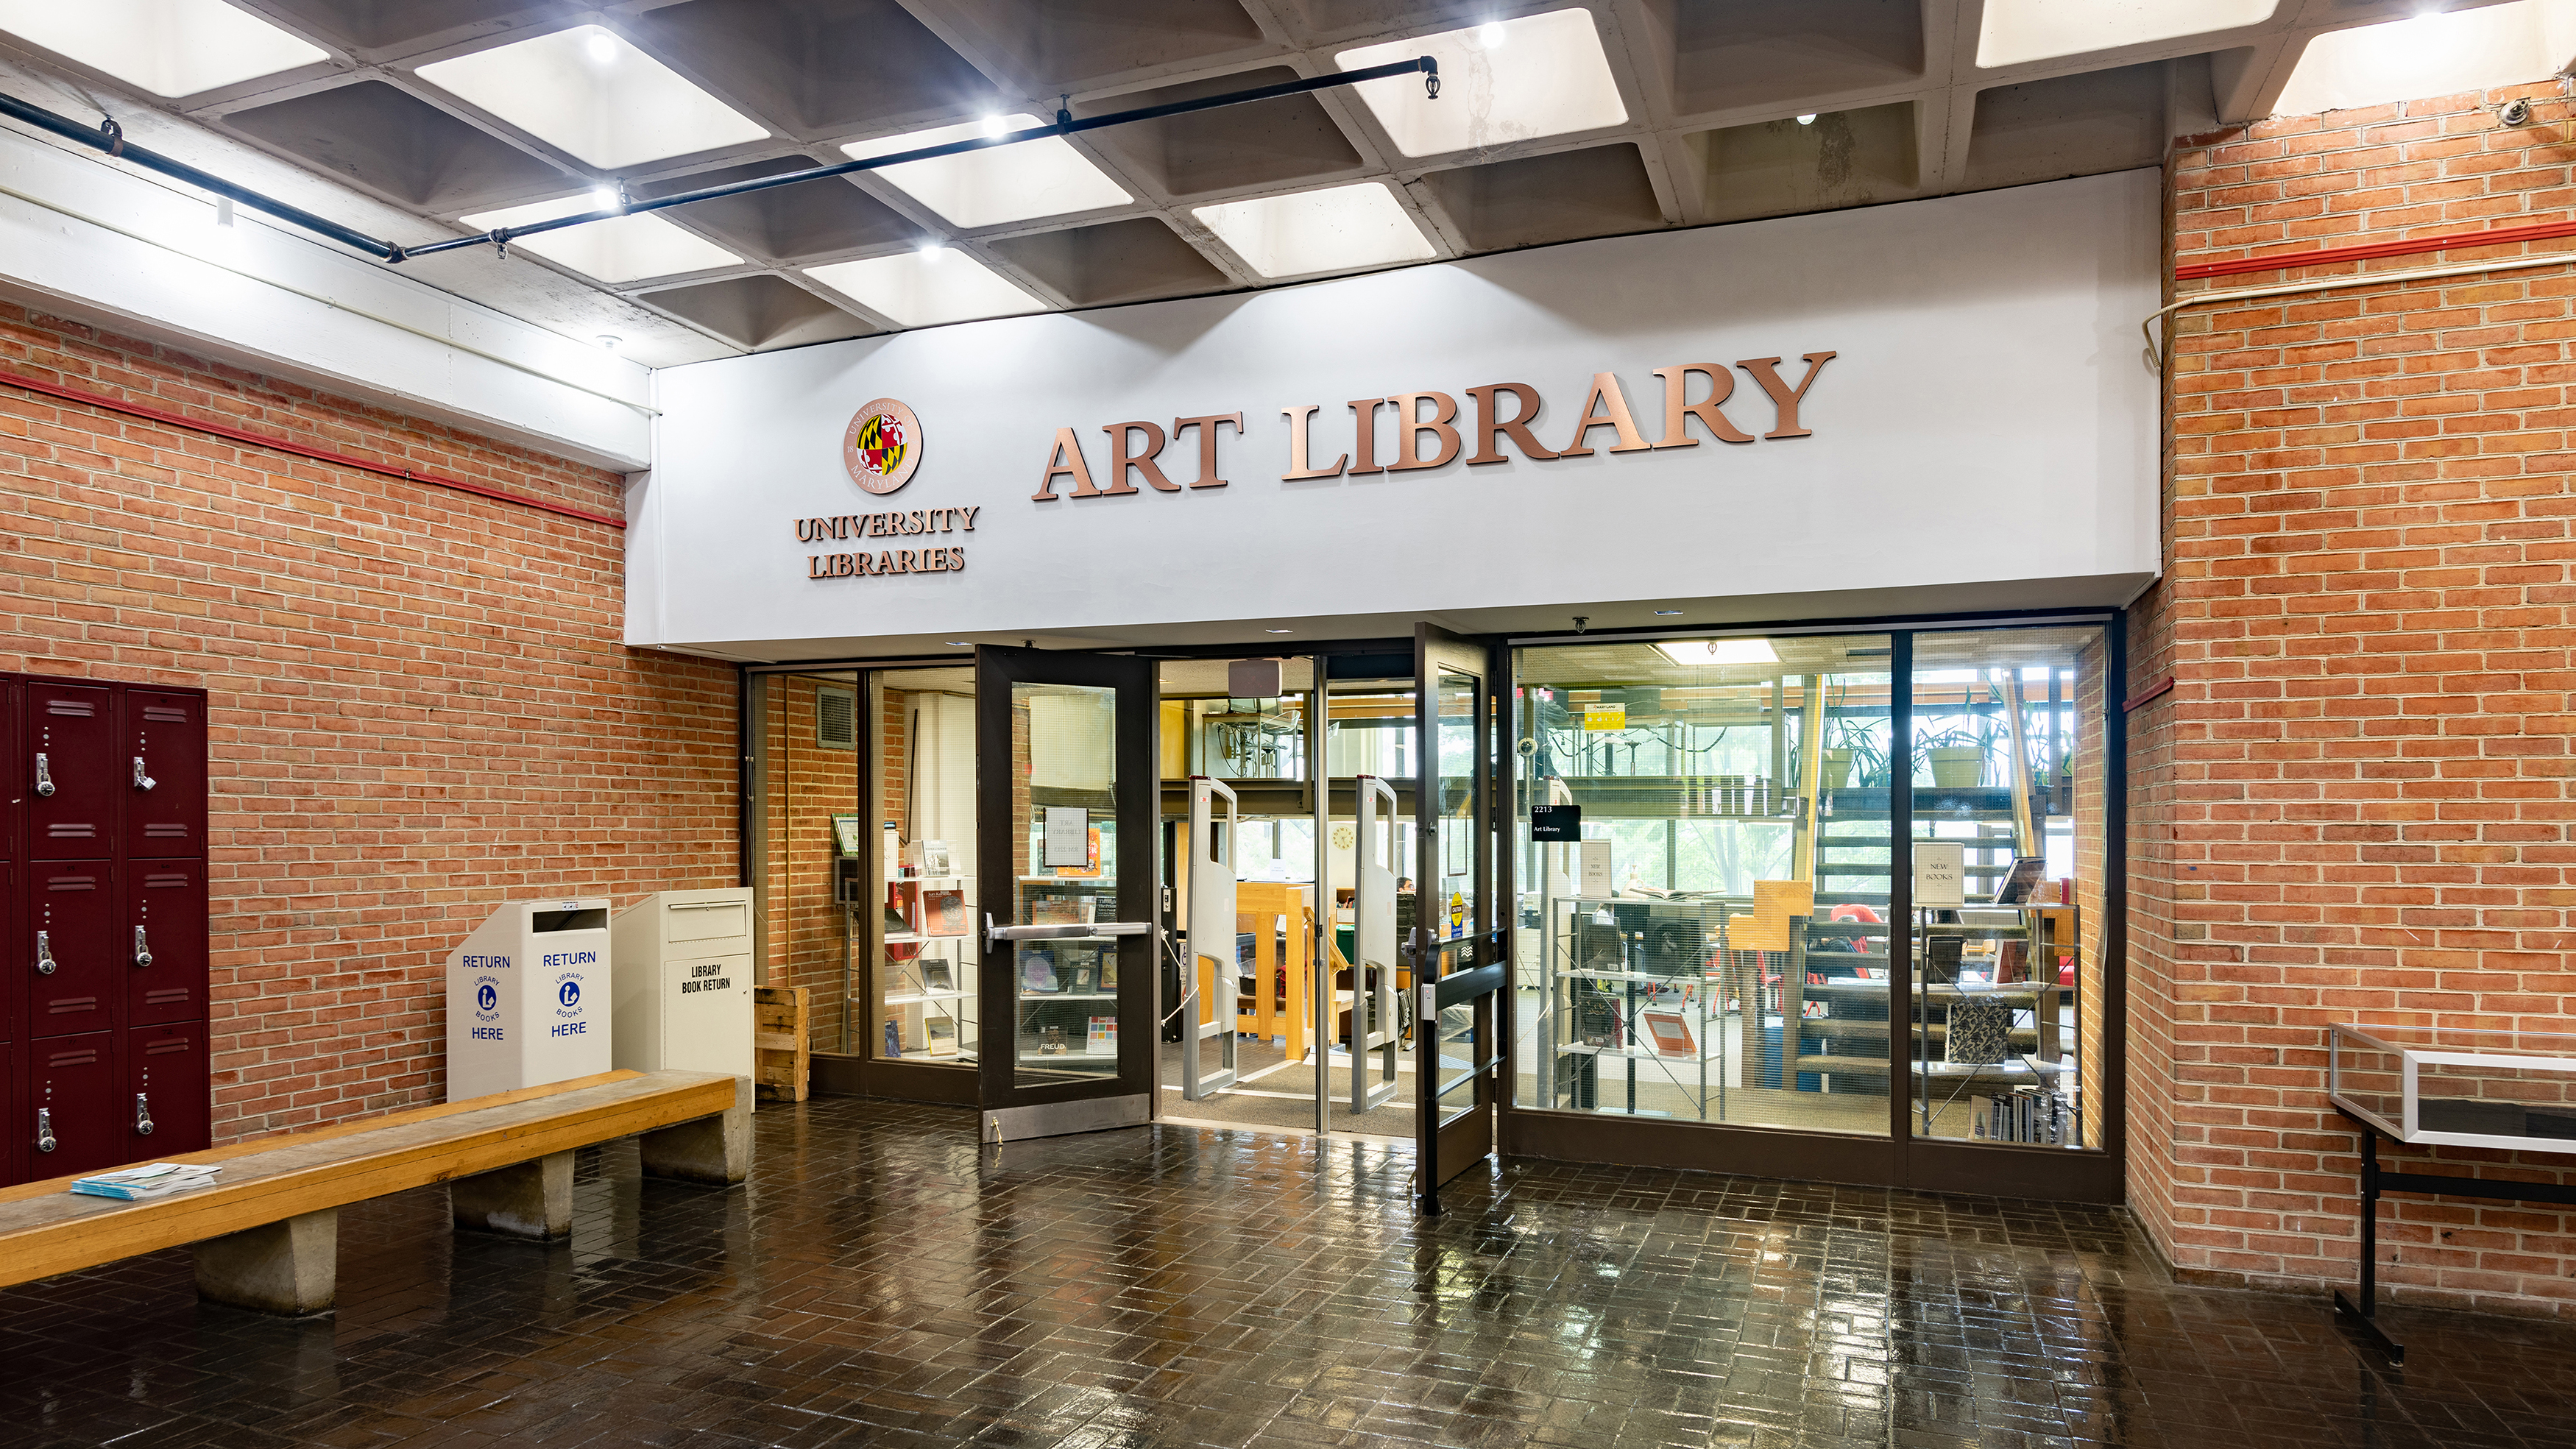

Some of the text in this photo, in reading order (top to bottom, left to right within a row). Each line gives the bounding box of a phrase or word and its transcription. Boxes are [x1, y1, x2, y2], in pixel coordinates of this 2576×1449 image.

[849, 402, 915, 435] UNIVERSITY OF
[1030, 350, 1837, 501] ART LIBRARY
[847, 445, 854, 453] 18
[851, 457, 914, 490] MARYLAND
[793, 505, 980, 542] UNIVERSITY
[807, 546, 966, 578] LIBRARIES
[463, 955, 511, 968] RETURN
[543, 951, 596, 968] RETURN
[555, 972, 584, 985] LIBRARY
[692, 963, 721, 978] LIBRARY
[474, 975, 500, 986] LIBRARY
[682, 977, 731, 994] BOOK RETURN
[475, 1010, 500, 1022] BOOKS
[556, 1006, 583, 1018] BOOKS
[472, 1027, 504, 1041] HERE
[551, 1021, 587, 1038] HERE
